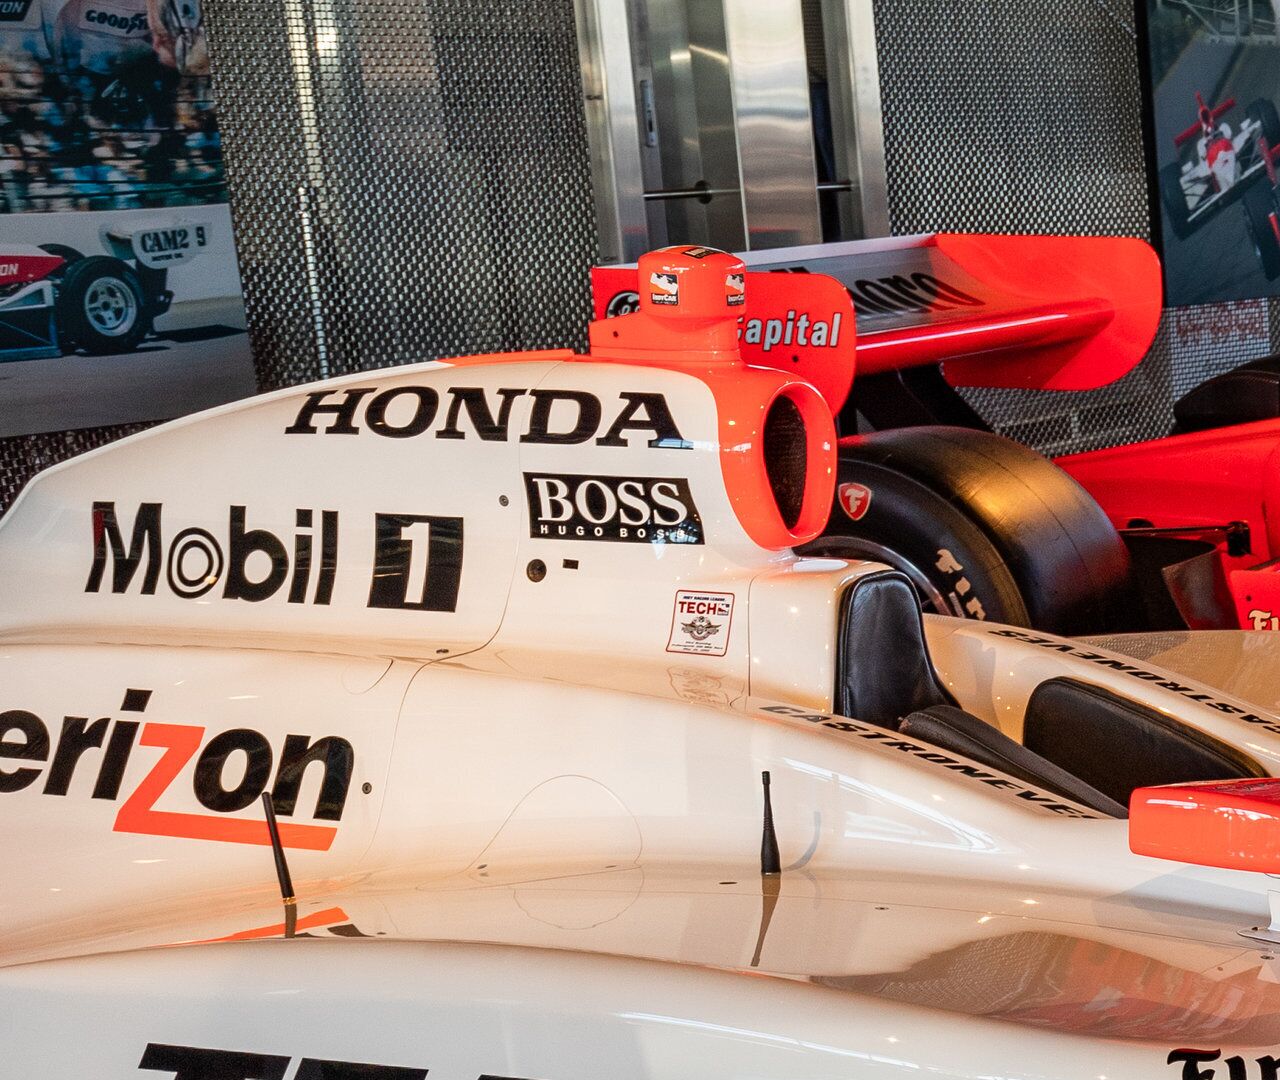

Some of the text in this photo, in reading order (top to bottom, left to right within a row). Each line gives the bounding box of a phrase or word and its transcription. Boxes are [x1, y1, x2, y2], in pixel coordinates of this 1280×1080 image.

[141, 229, 190, 253] CAM2
[285, 386, 694, 450] HONDA
[532, 478, 688, 527] BOSS
[85, 501, 338, 606] Mobil
[540, 524, 685, 539] HUGO BOSS
[679, 601, 717, 615] TECH
[0, 688, 355, 851] erizon
